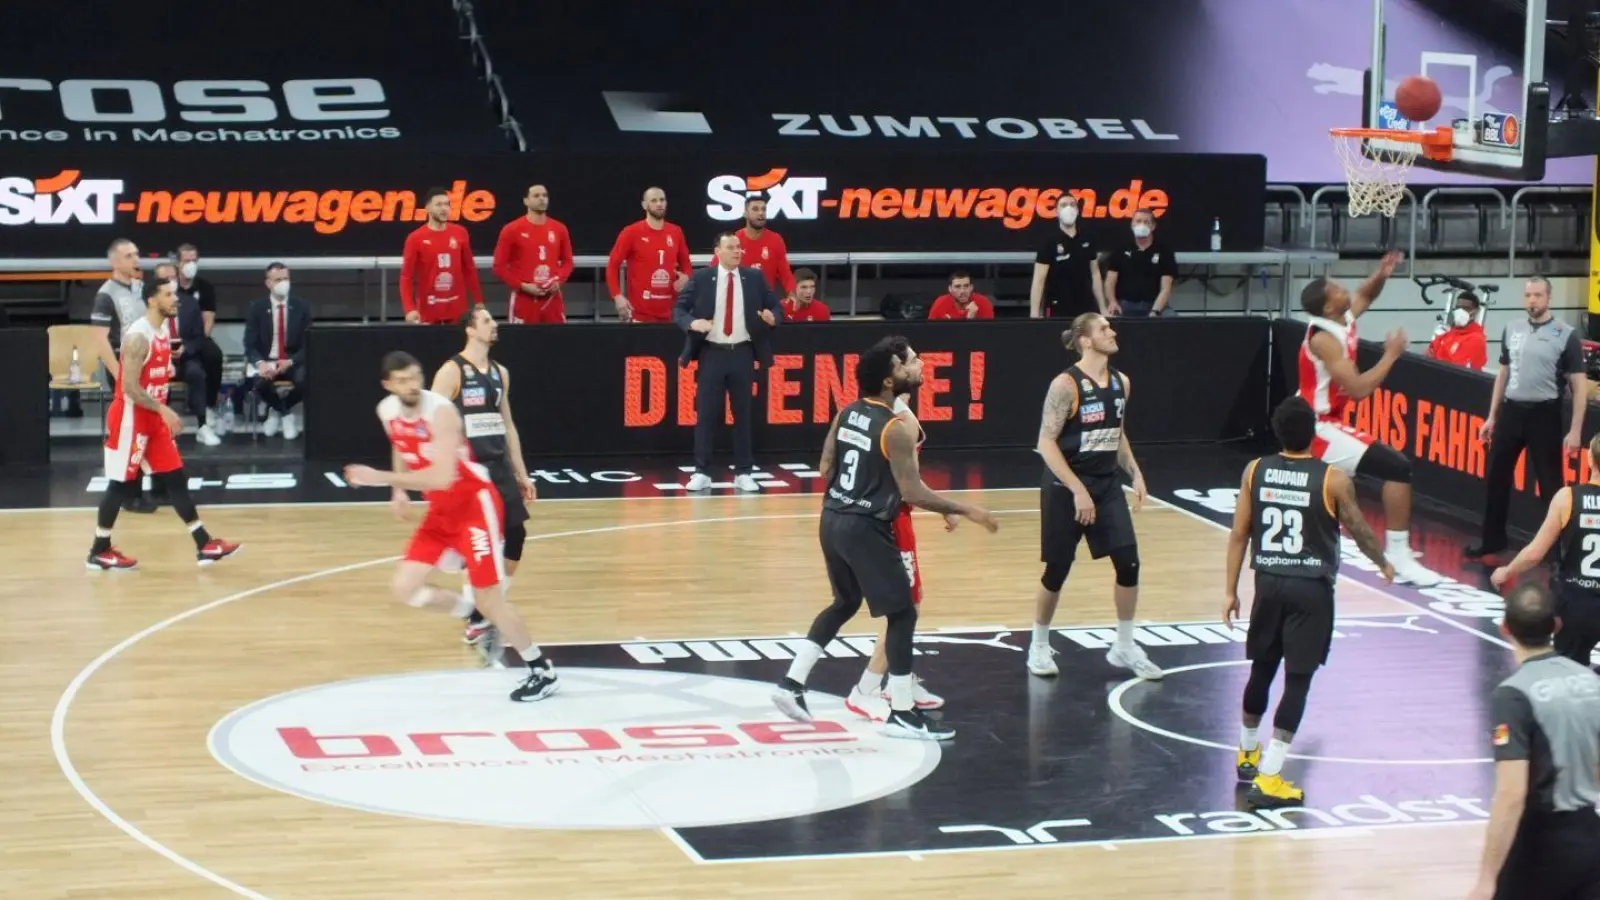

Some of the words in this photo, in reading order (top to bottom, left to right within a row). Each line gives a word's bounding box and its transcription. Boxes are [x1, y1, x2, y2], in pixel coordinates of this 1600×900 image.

[83, 127, 118, 142] in
[133, 124, 401, 143] Mechatronics
[771, 112, 1180, 141] ZUMTOBEL
[840, 449, 860, 491] 3
[1264, 468, 1309, 487] CAUPAIN
[1261, 507, 1303, 554] 23
[276, 720, 858, 759] brose
[300, 759, 528, 772] Excellence
[596, 747, 878, 763] Mechatronics
